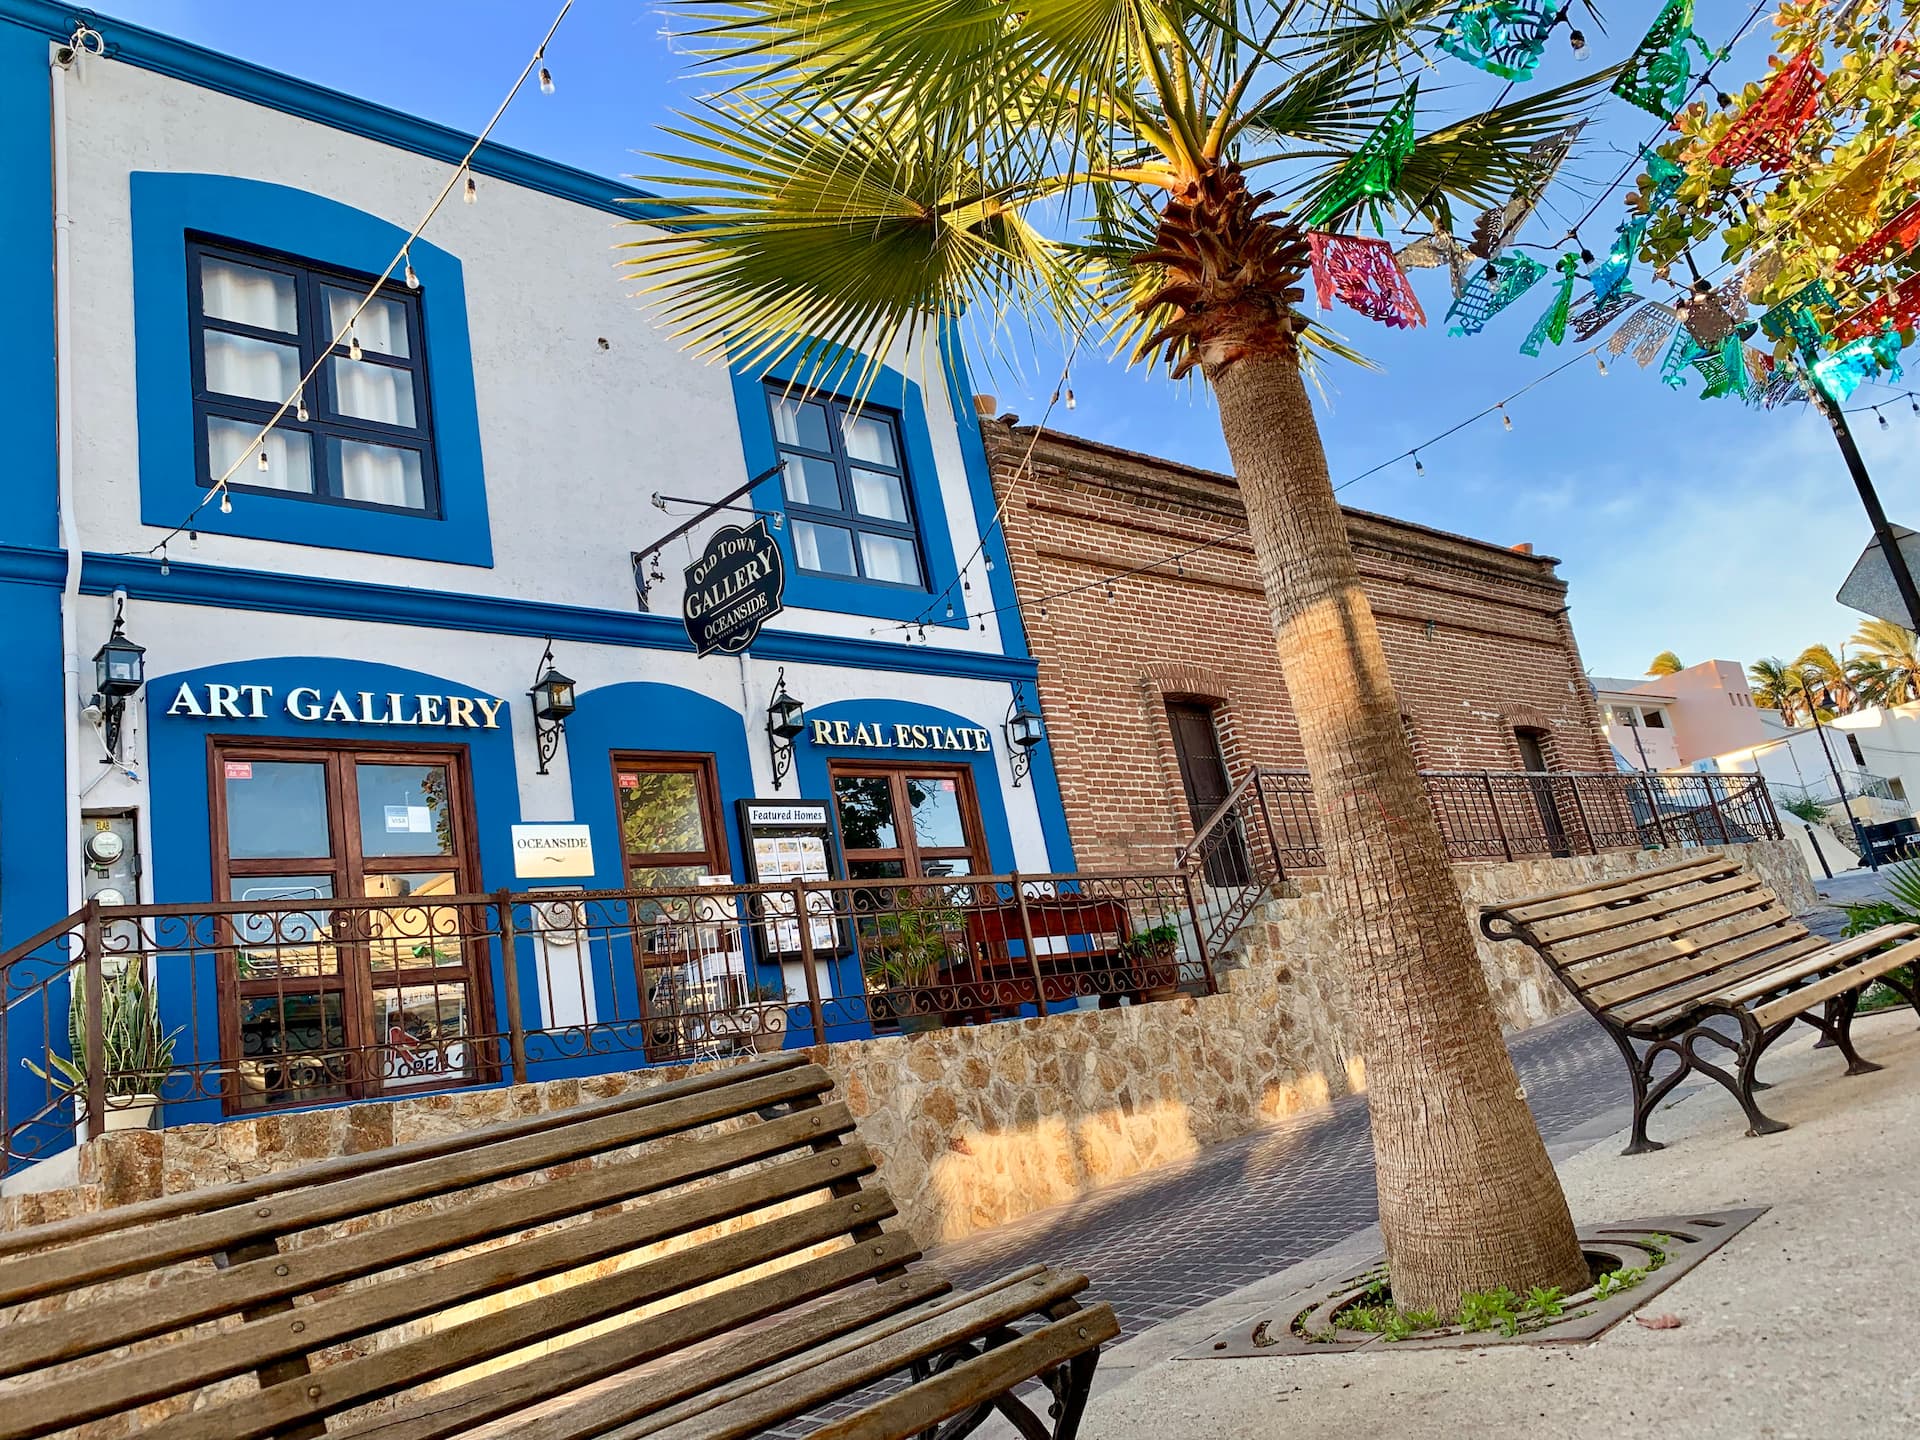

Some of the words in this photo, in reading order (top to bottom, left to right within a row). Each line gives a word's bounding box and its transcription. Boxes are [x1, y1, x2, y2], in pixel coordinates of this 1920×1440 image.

[686, 545, 773, 619] GALLERY
[694, 553, 718, 585] OLD
[718, 537, 756, 560] TOWN
[704, 592, 768, 640] OCEANSIDE
[167, 681, 272, 718] ART
[286, 688, 504, 729] GALLERY
[811, 719, 892, 748] REAL
[893, 724, 990, 752] ESTATE
[753, 810, 791, 820] Featured
[794, 809, 822, 820] Homes
[517, 838, 588, 849] OCEANSIDE
